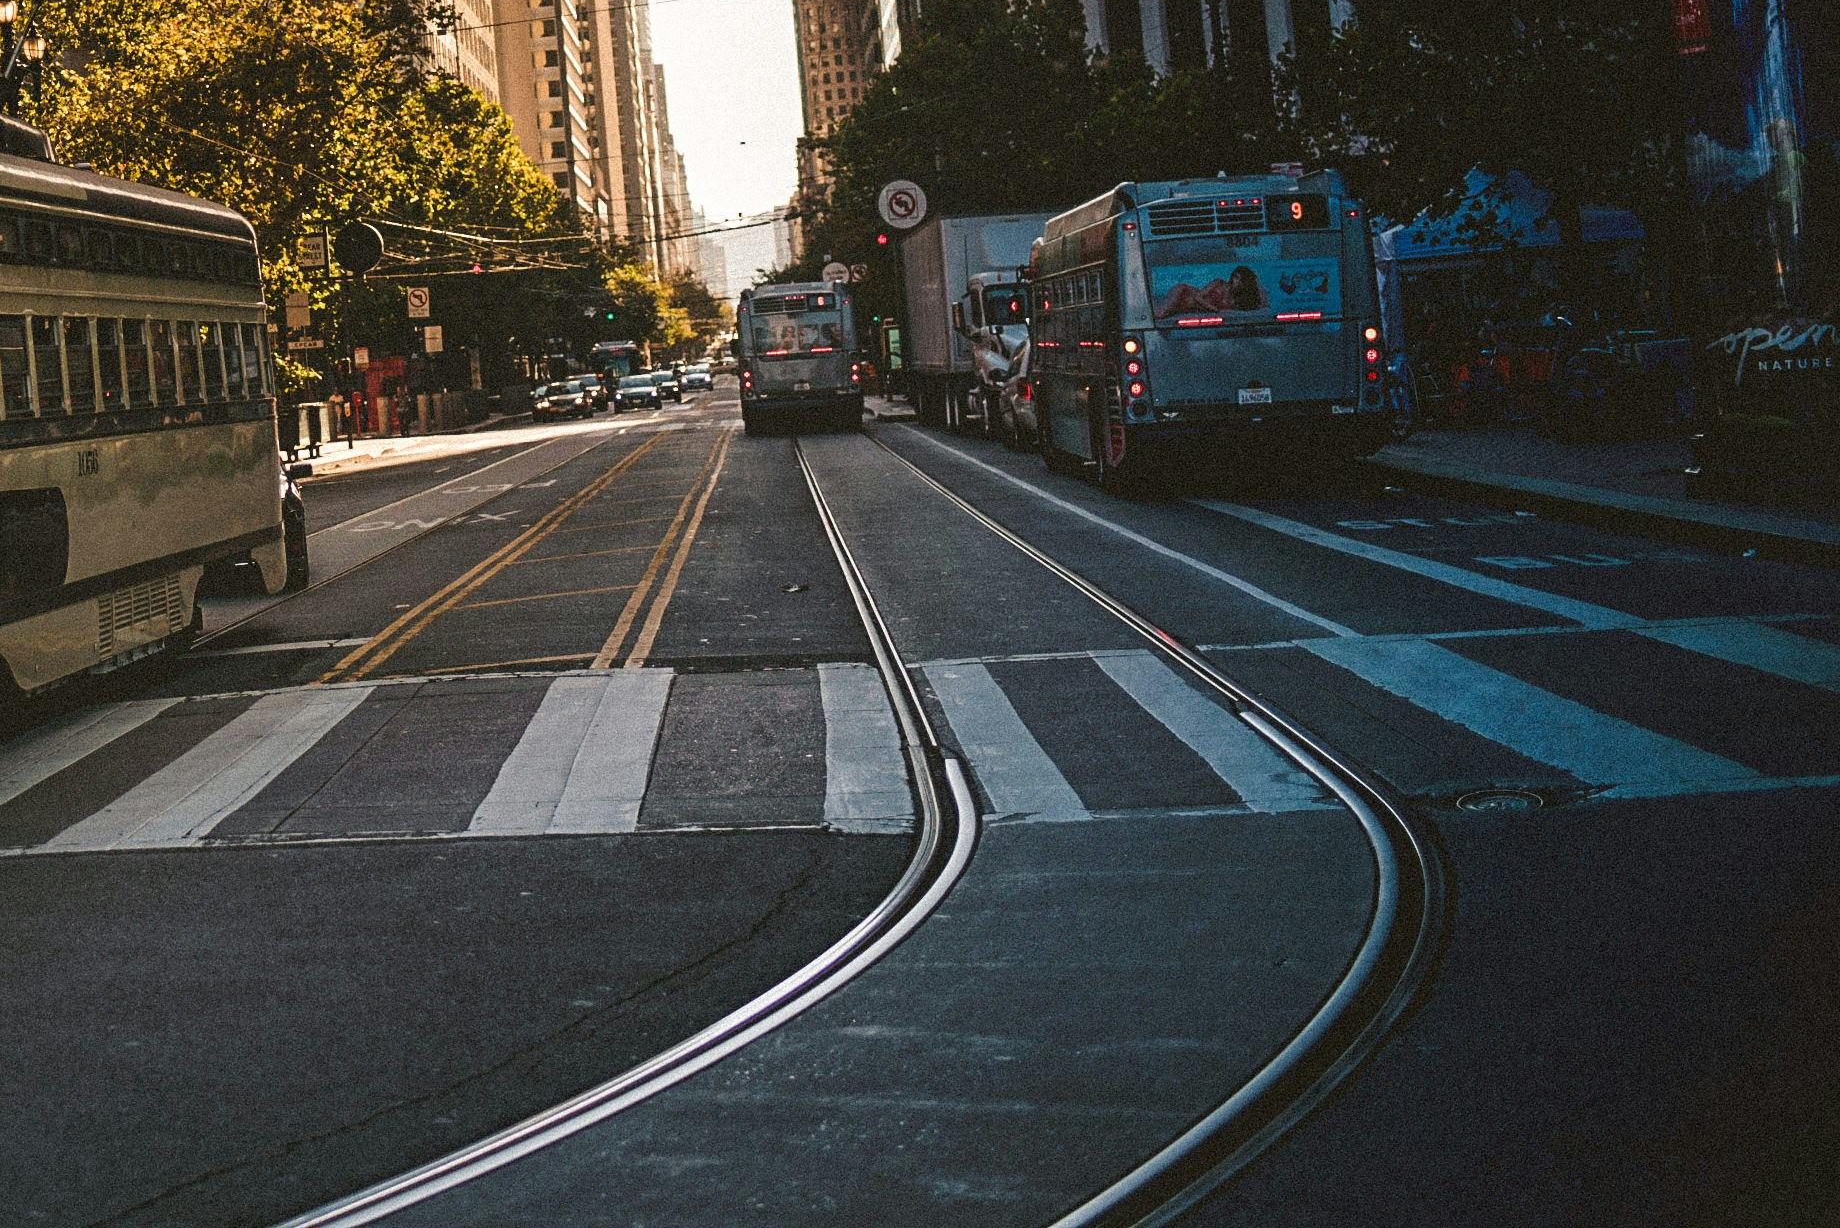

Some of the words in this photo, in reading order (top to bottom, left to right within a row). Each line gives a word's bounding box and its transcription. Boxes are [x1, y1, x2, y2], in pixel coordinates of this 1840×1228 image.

[1290, 201, 1303, 220] 9
[1758, 357, 1834, 372] NATURE
[77, 449, 99, 477] 1056
